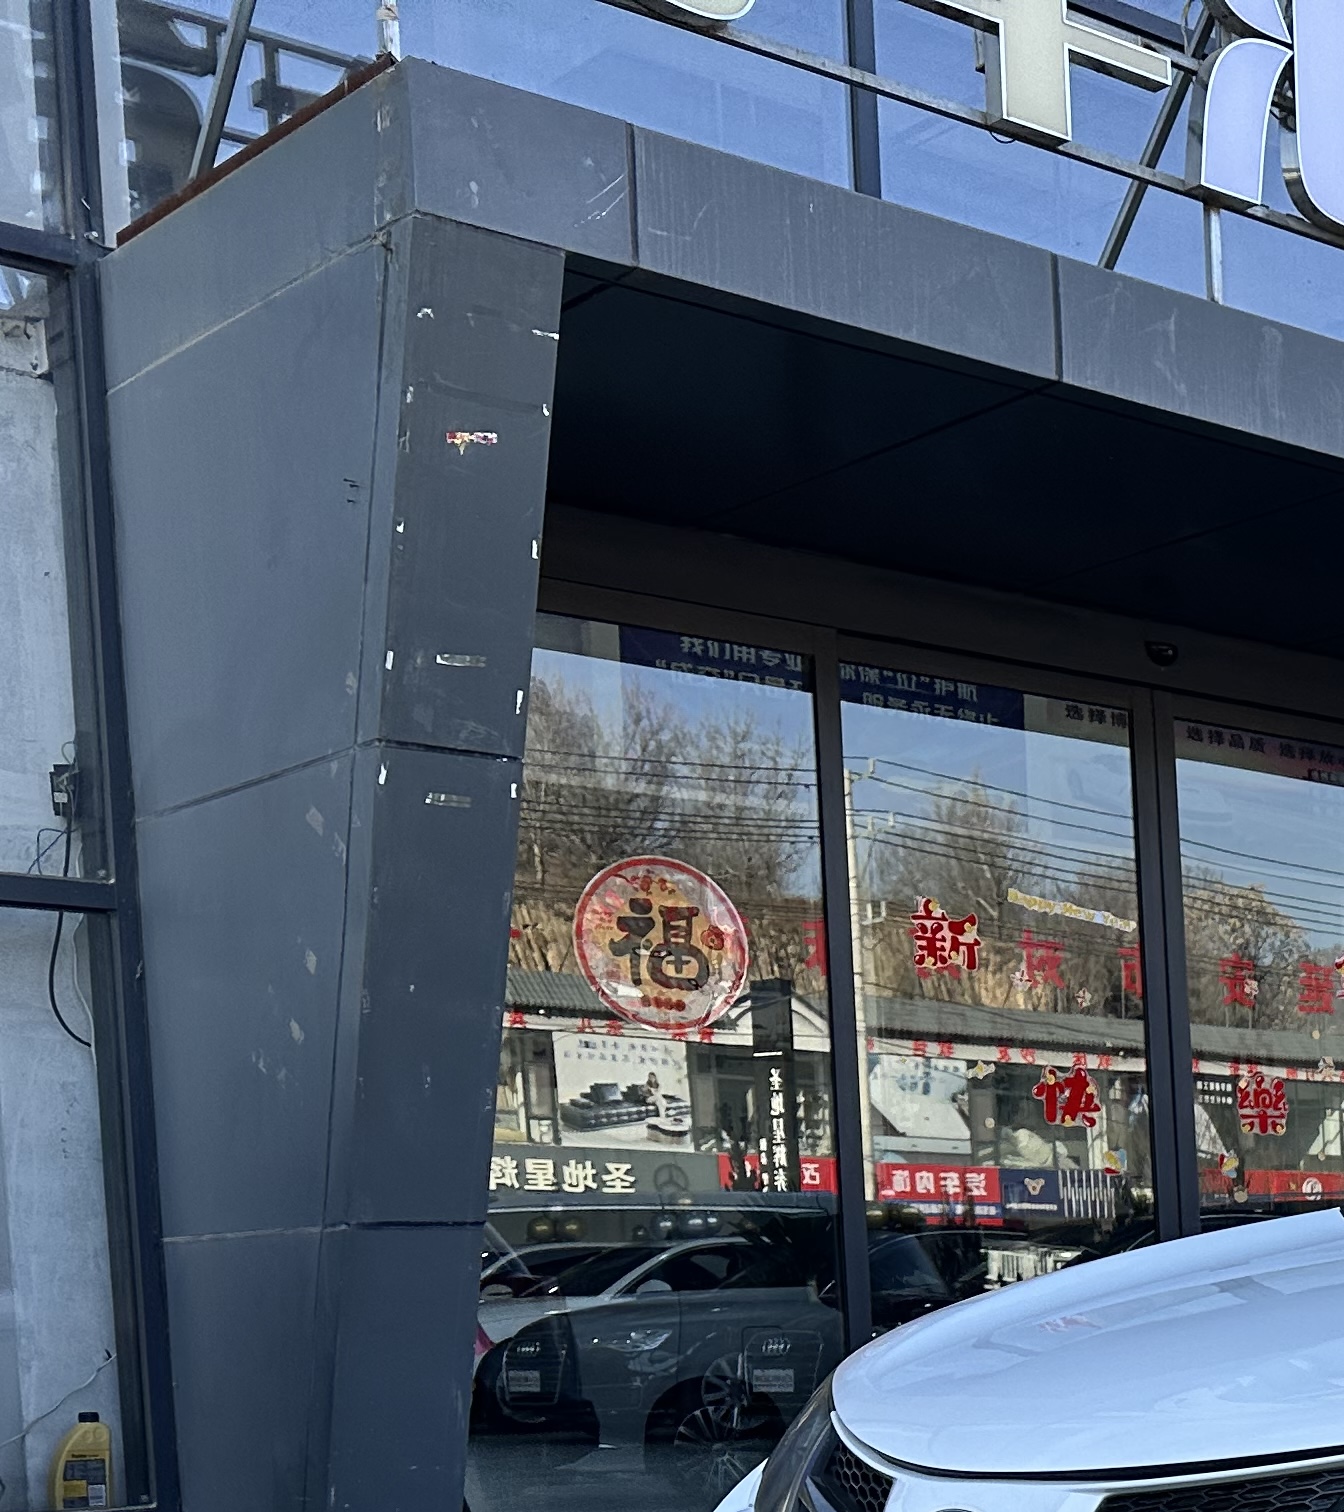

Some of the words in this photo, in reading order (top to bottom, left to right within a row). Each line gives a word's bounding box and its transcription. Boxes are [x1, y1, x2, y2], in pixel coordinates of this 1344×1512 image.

[608, 897, 710, 991] 福
[911, 897, 982, 971] 新
[1031, 1065, 1102, 1129] 快
